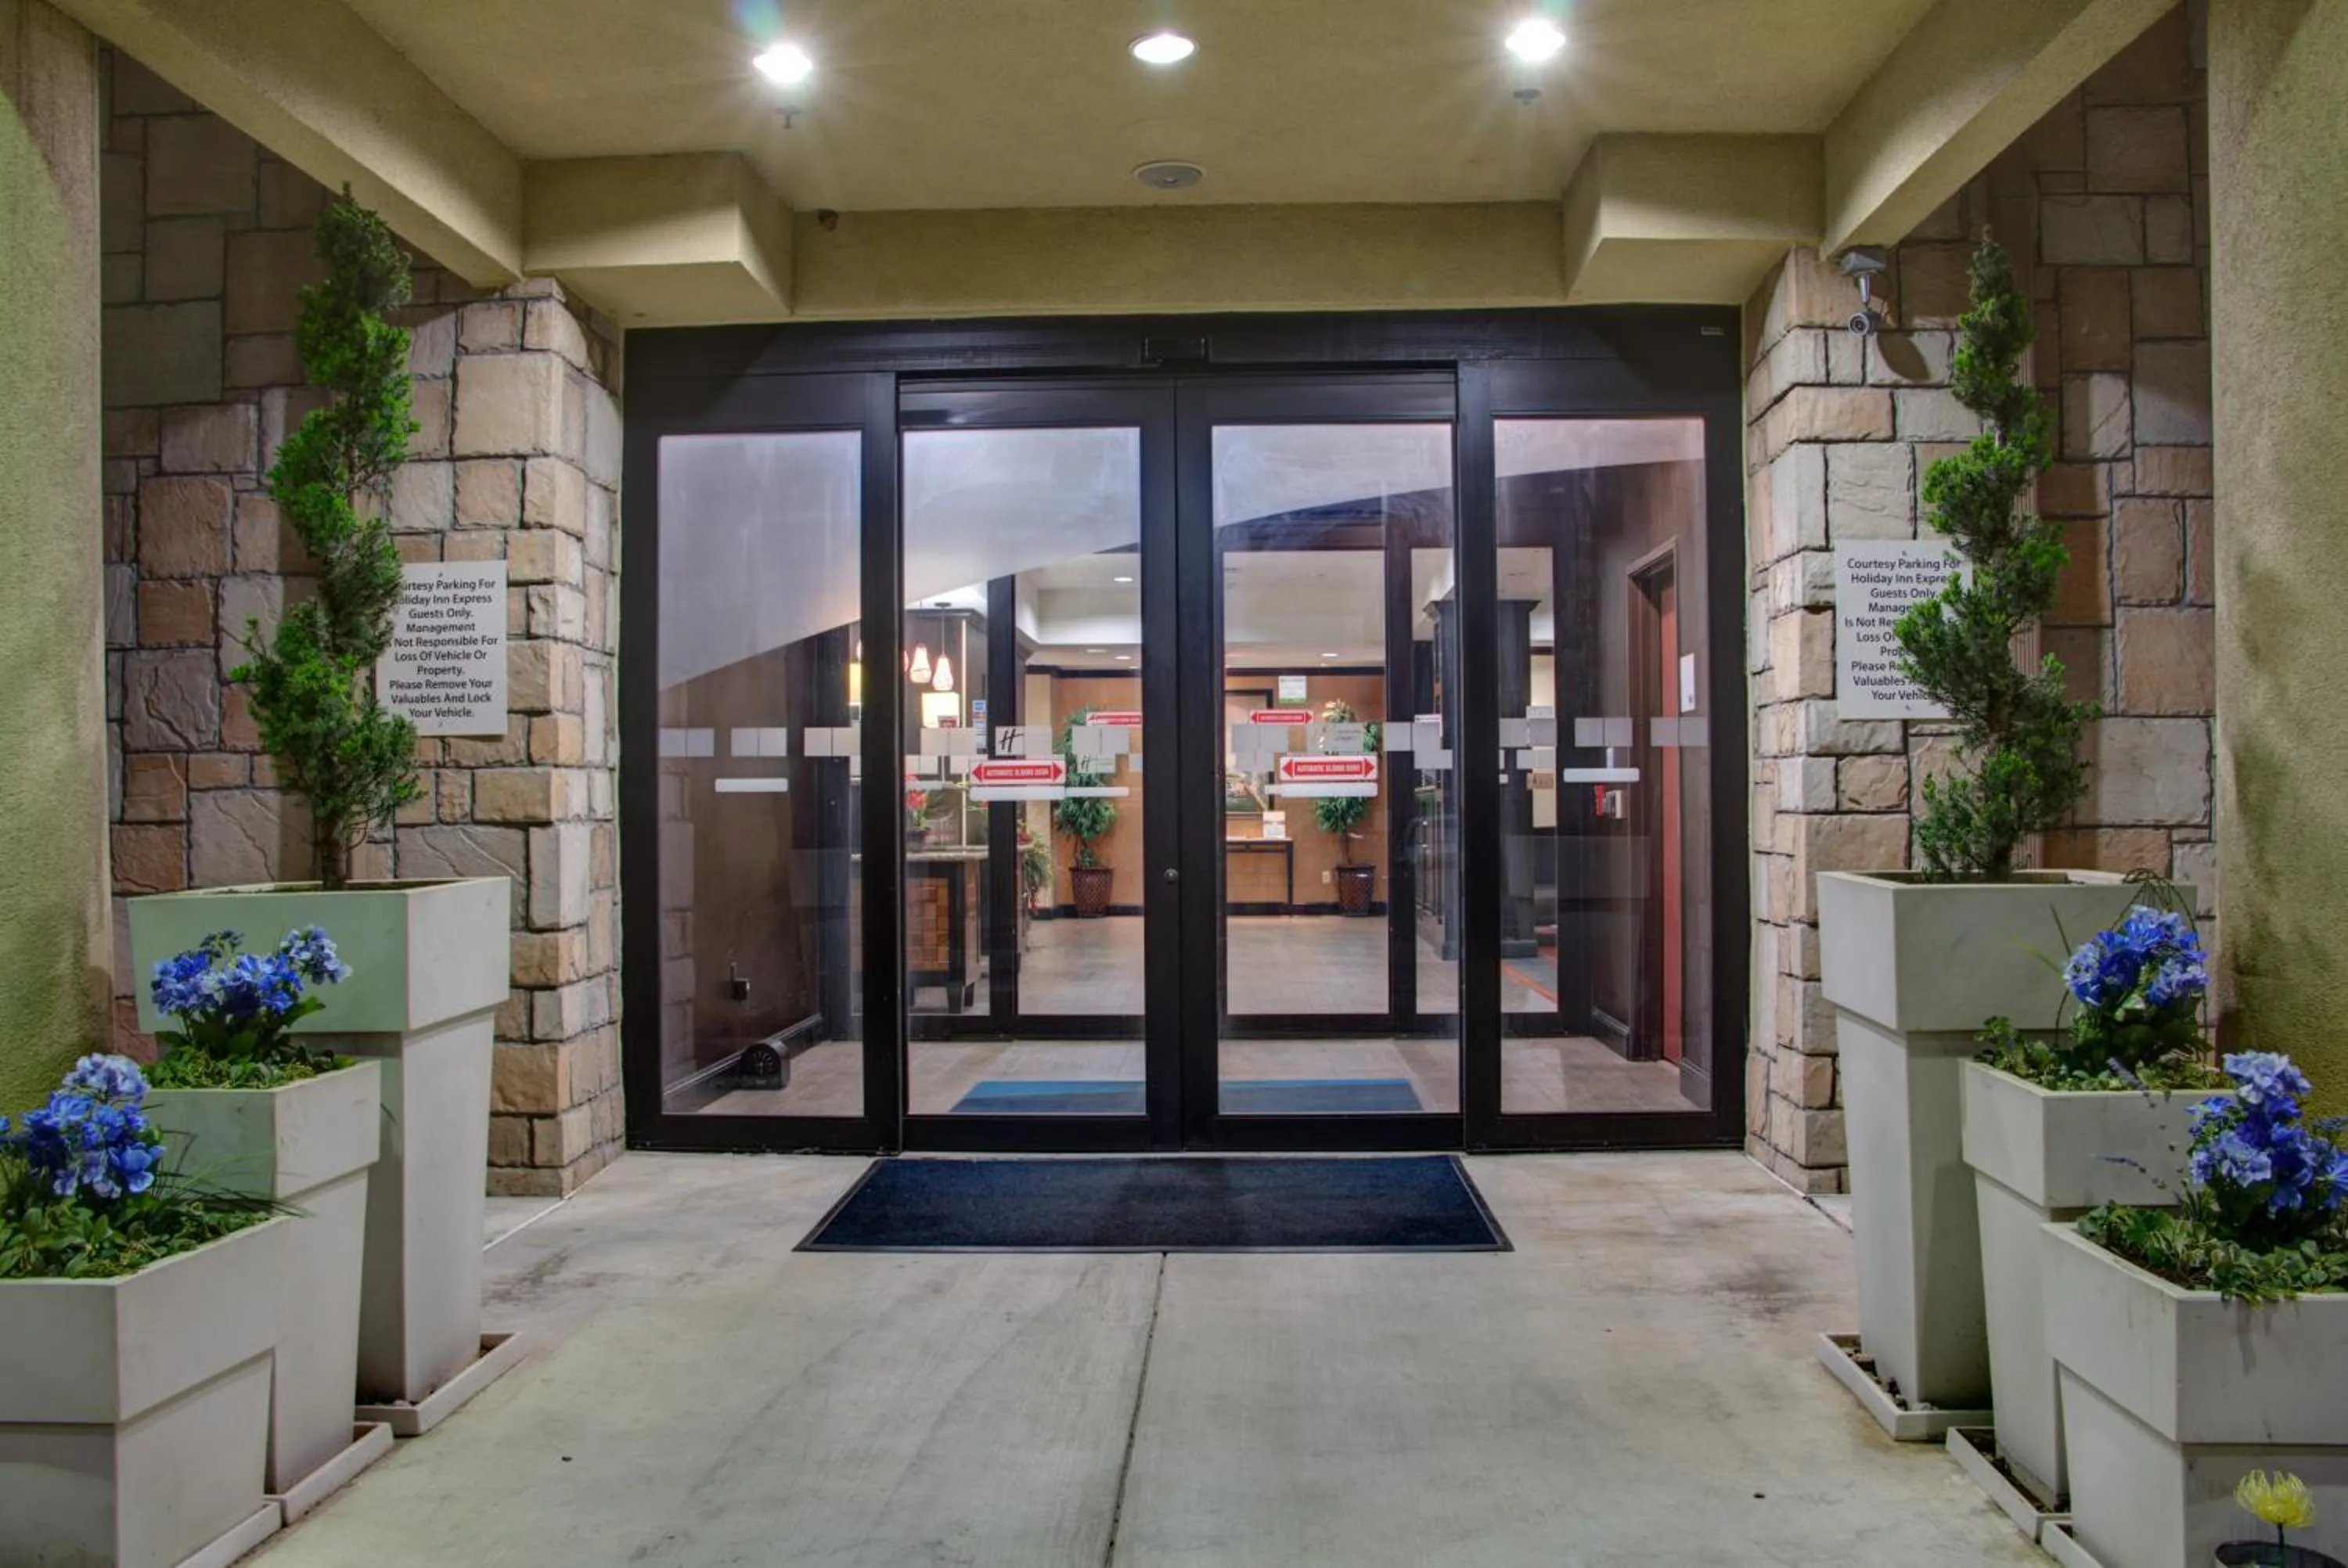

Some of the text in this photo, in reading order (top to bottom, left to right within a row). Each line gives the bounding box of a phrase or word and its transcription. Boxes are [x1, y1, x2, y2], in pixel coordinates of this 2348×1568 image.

[1847, 558, 1961, 571] Courtesy Parking For
[1851, 573, 1948, 585] Holiday Inn Expre
[436, 579, 477, 592] Parking
[478, 578, 496, 588] For
[1870, 588, 1907, 599] Guests
[433, 595, 450, 604] Inn
[452, 594, 492, 606] Express
[409, 609, 444, 619] Guests
[1845, 617, 1853, 627] Is
[1856, 617, 1876, 627] Not
[406, 623, 476, 635] Management
[394, 635, 499, 649] Not Responsible For
[1856, 632, 1880, 642] Loss
[394, 649, 488, 662] Loss Of Vehicle Or
[417, 665, 465, 676] Property.
[1852, 661, 1886, 671] Please
[389, 678, 493, 689] Please Remove Your
[1853, 676, 1905, 686] Valuables
[391, 692, 492, 704] Valuables And Lock
[1871, 690, 1896, 700] Your
[409, 708, 433, 718] Your
